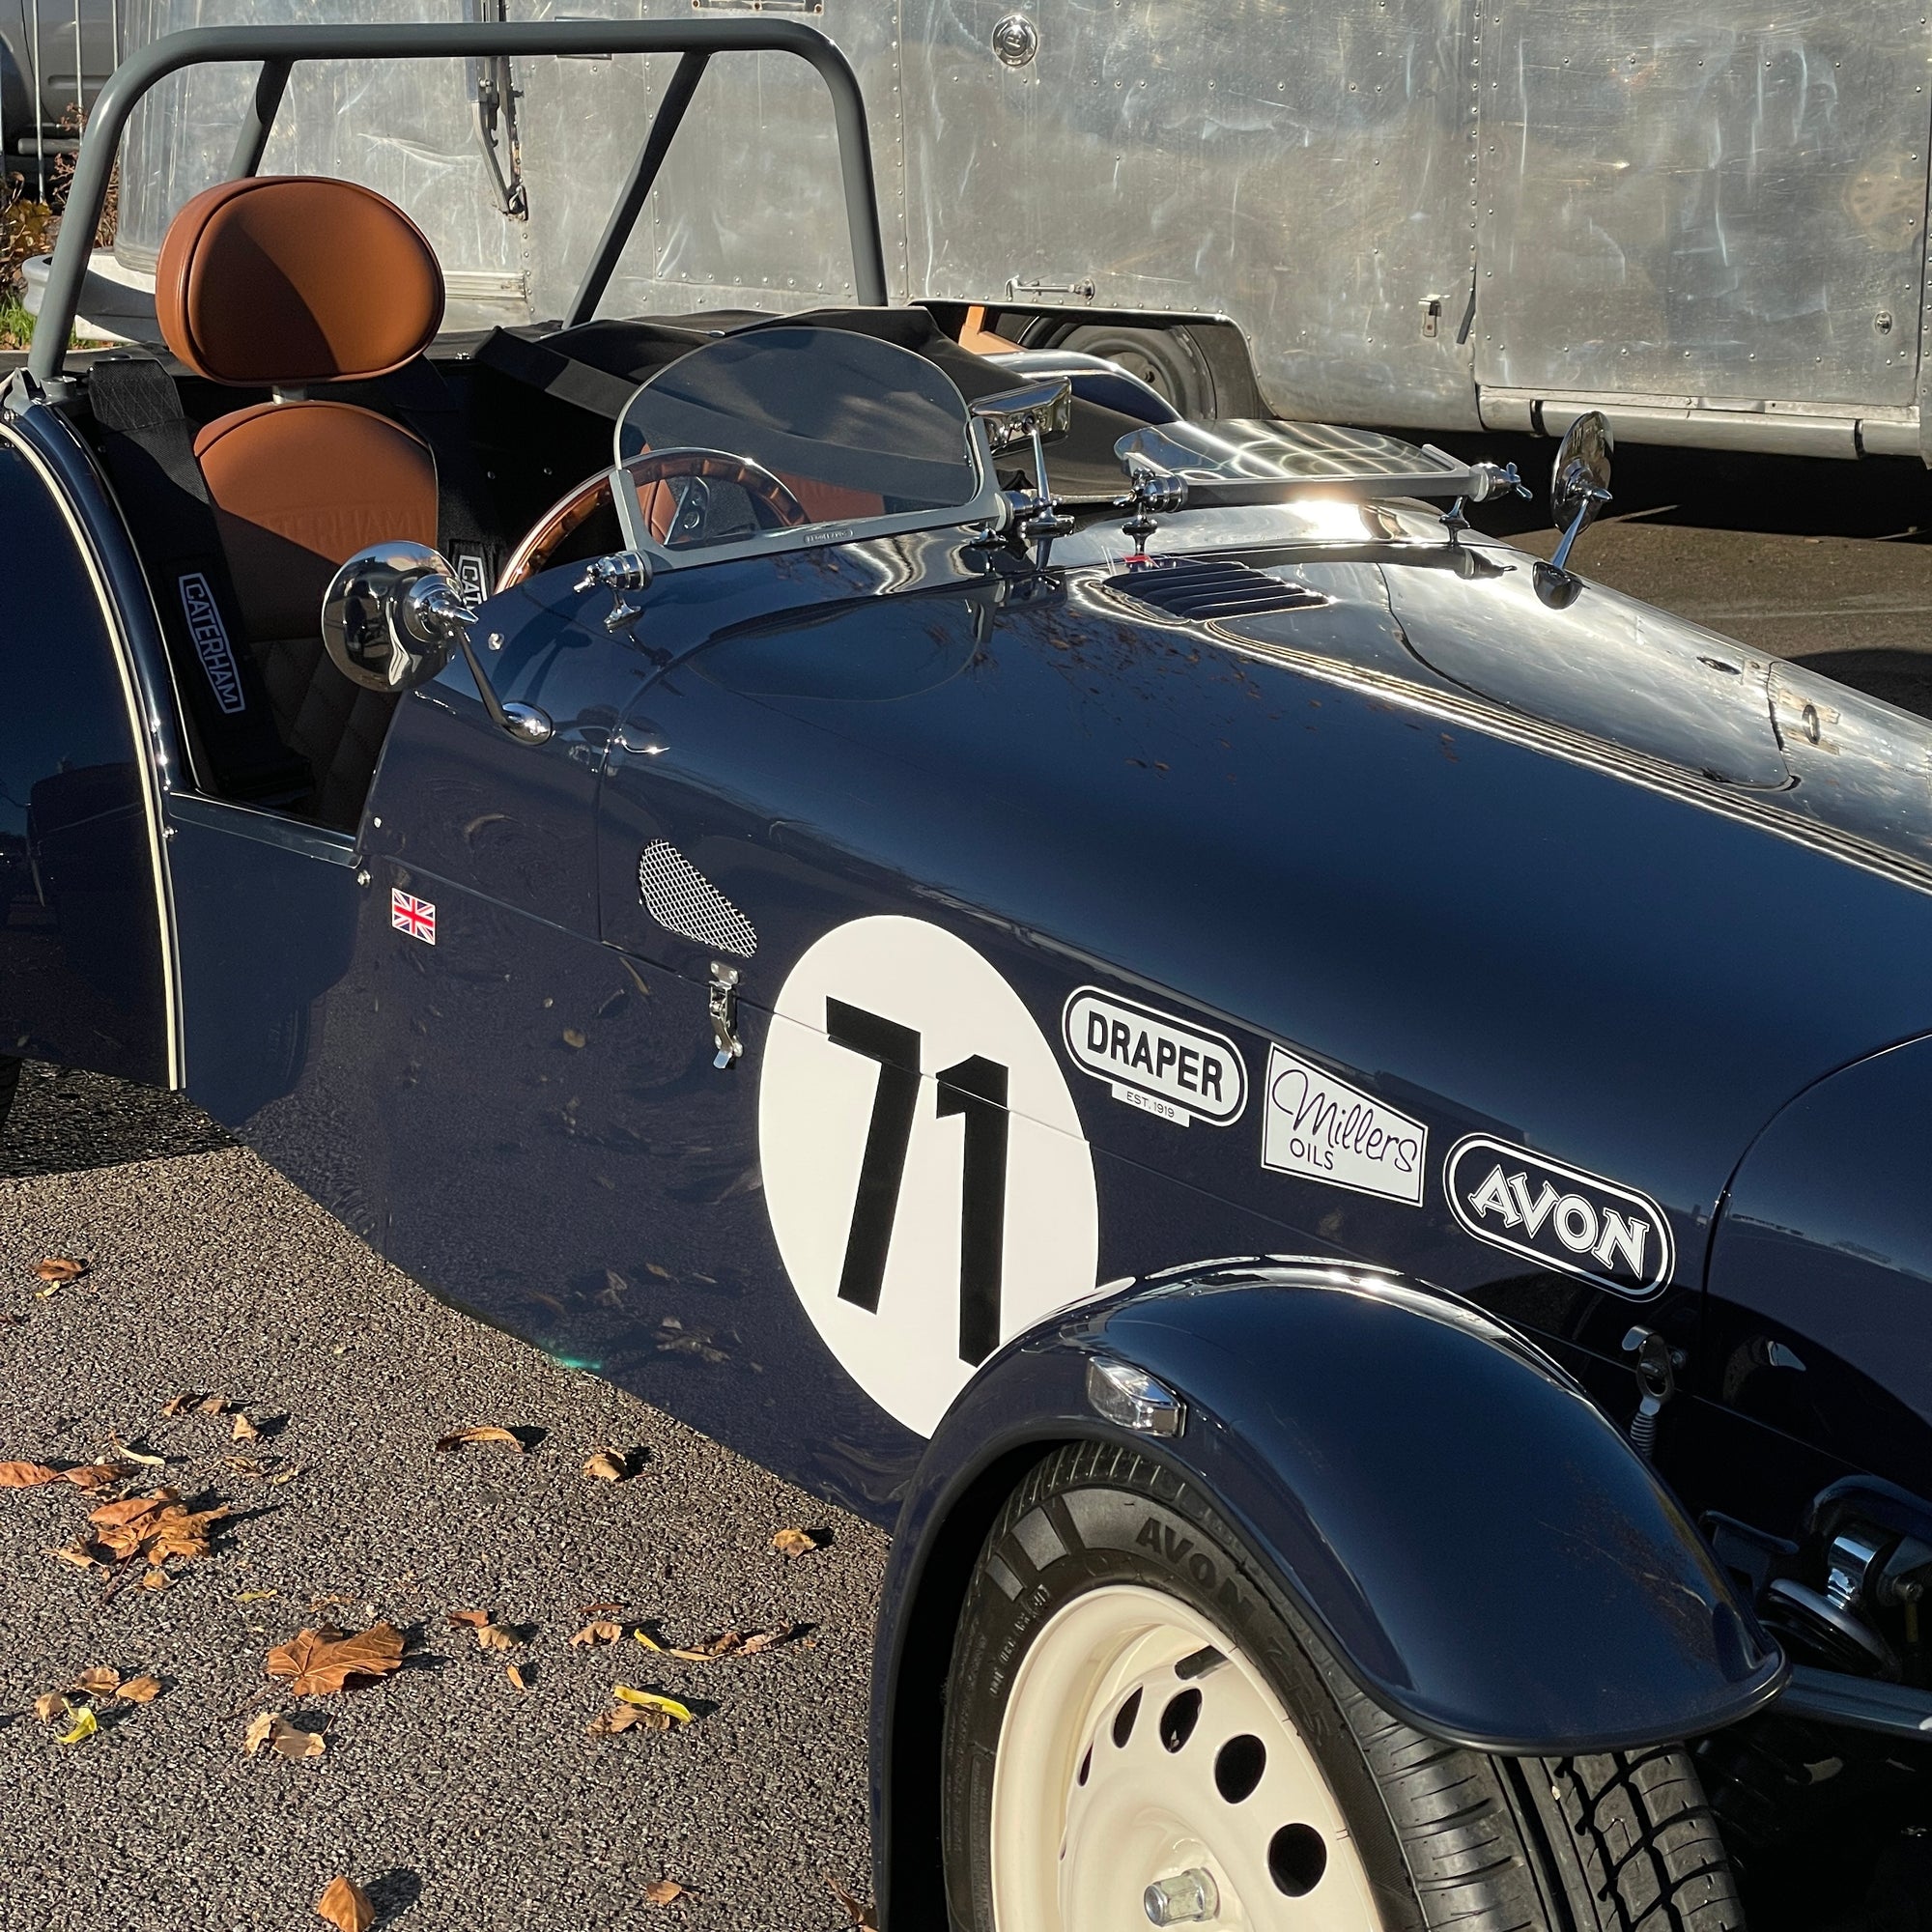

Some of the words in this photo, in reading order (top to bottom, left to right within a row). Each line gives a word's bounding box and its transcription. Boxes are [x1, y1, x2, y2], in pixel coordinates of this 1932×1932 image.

[185, 582, 239, 704] CATERHAM
[1086, 1009, 1224, 1103] DRAPER
[1152, 1102, 1176, 1119] 1919
[1271, 1067, 1418, 1174] Millers
[1289, 1137, 1335, 1172] OILS
[825, 995, 1009, 1369] 71
[1467, 1163, 1650, 1281] AVON
[1135, 1516, 1259, 1623] AVON
